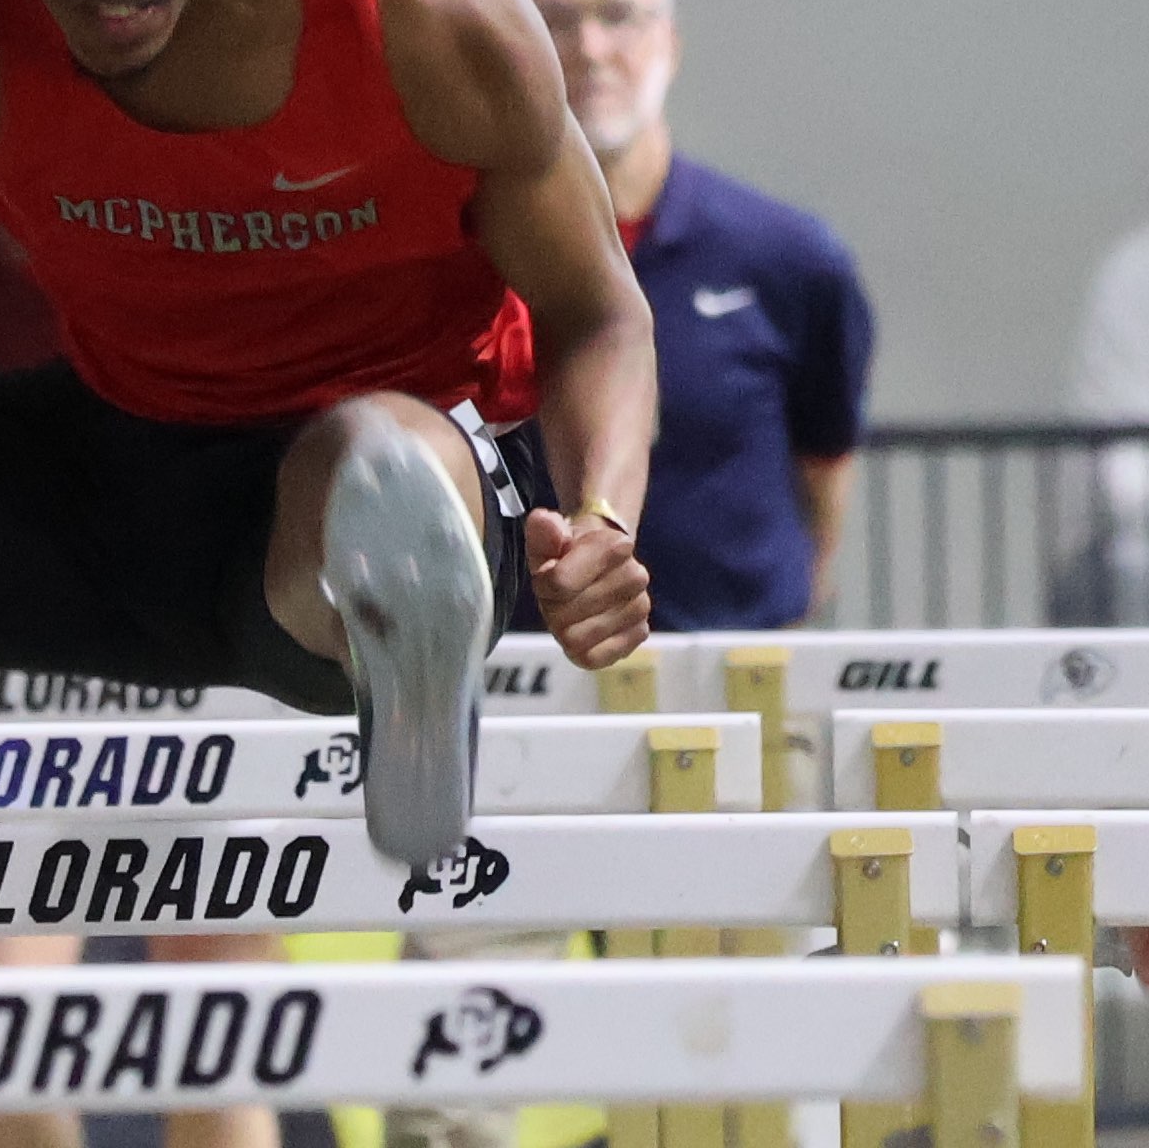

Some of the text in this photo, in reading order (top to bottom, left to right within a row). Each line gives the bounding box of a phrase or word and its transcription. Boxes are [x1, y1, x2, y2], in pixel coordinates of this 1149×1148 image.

[54, 195, 379, 252] MCPHERSON
[484, 665, 550, 695] ILL
[837, 659, 940, 692] GILL
